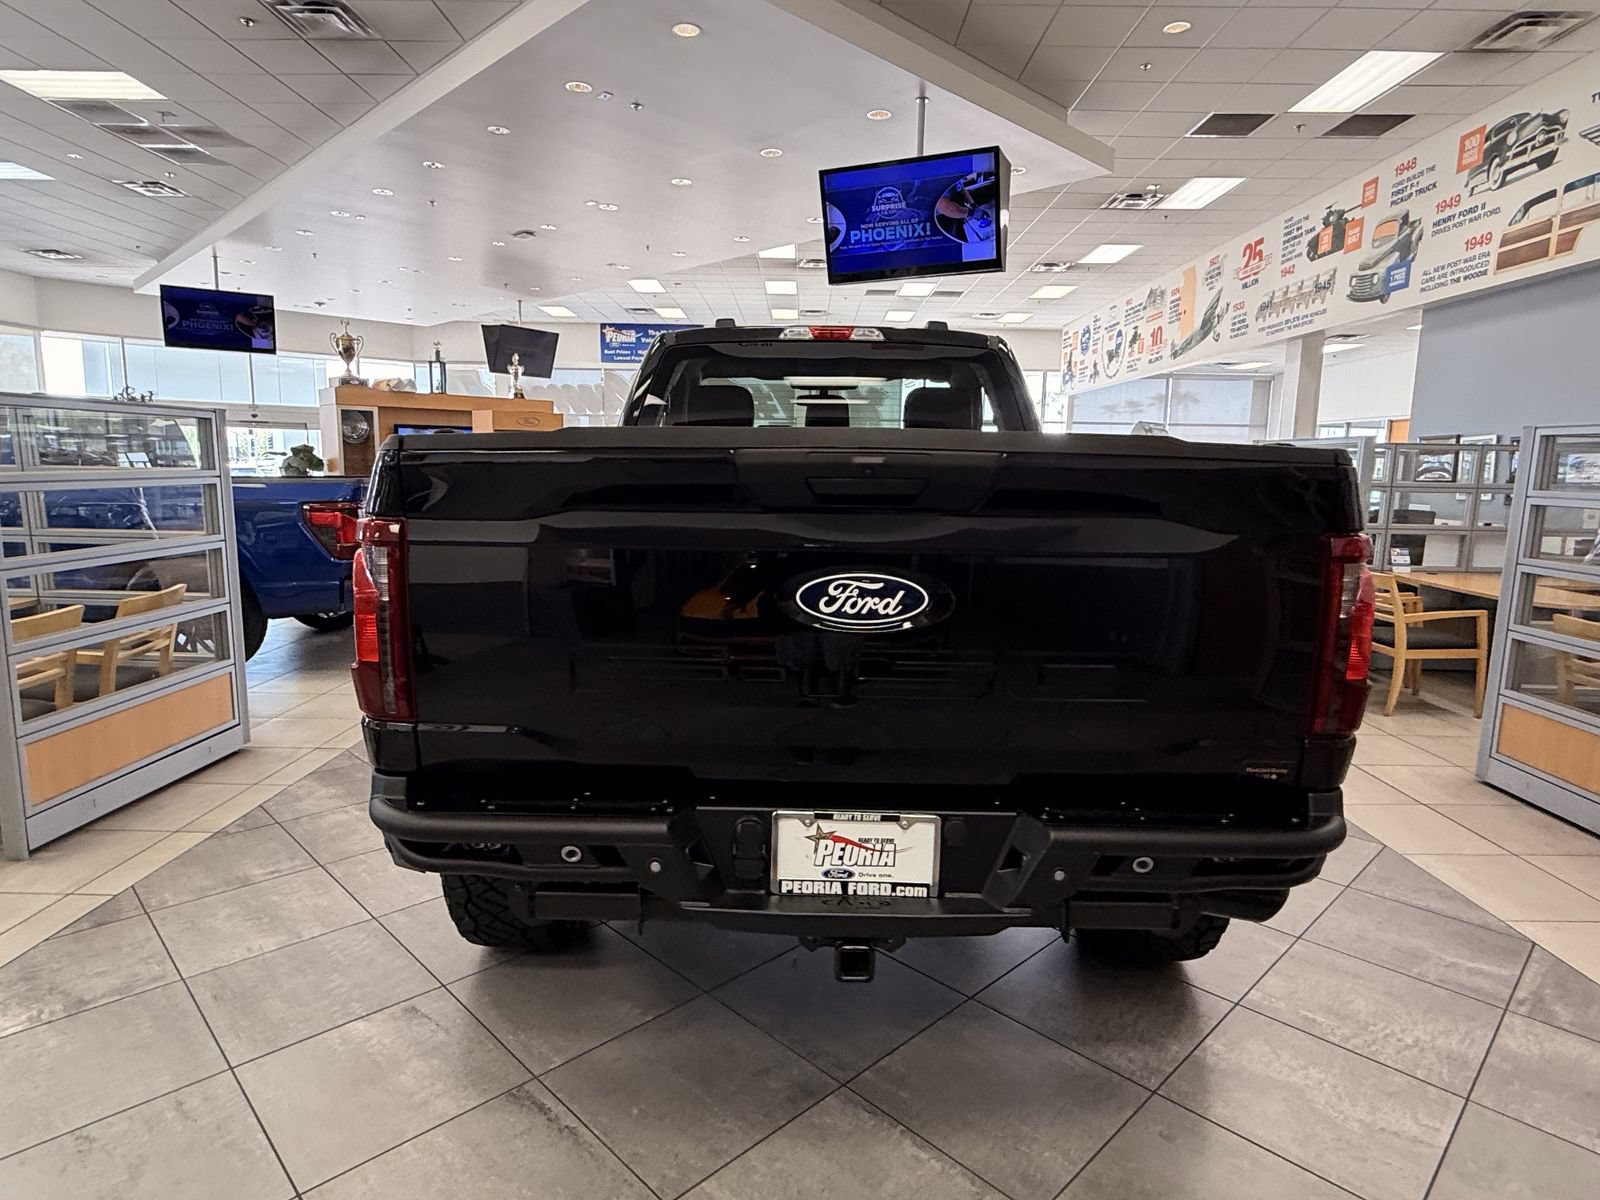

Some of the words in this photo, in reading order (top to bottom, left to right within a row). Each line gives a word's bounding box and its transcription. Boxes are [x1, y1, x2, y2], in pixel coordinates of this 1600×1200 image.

[1394, 156, 1417, 177] 1948
[1390, 192, 1414, 208] PICKUP
[1415, 181, 1438, 197] TRUCK
[1391, 185, 1409, 199] FIRST
[1410, 181, 1420, 190] F-1
[871, 201, 907, 213] SURPRISE
[1435, 194, 1462, 215] 1949
[875, 220, 899, 228] SERVING
[1431, 225, 1451, 237] DRIVES
[1451, 219, 1467, 230] POST
[1468, 213, 1482, 224] WAR
[1432, 213, 1457, 229] HENRY
[1458, 205, 1479, 219] FORD
[850, 222, 931, 244] PHOENIX!
[1463, 231, 1494, 252] 1949
[1241, 236, 1265, 270] 25
[1280, 264, 1297, 279] 1942
[1421, 275, 1436, 286] CARS
[1436, 271, 1449, 281] ARE
[1449, 260, 1490, 278] INTRODUCED
[1422, 269, 1432, 278] ALL
[1432, 262, 1447, 274] NEW
[1446, 254, 1478, 270] POST-WAR
[1477, 250, 1491, 261] ERA
[1241, 278, 1260, 290] MILLION
[1315, 279, 1332, 293] 1945
[1420, 281, 1449, 294] INCLUDING
[1449, 276, 1462, 286] THE
[1463, 268, 1489, 281] WOODIE
[182, 320, 234, 331] PHOENIX!
[1150, 325, 1163, 348] 10
[819, 580, 906, 616] Ford
[833, 813, 853, 821] READY
[862, 814, 881, 822] SERVE
[814, 840, 896, 867] PEORIA
[828, 870, 850, 879] Ford
[781, 880, 843, 895] PEORIA
[848, 881, 928, 897] FORD.com
